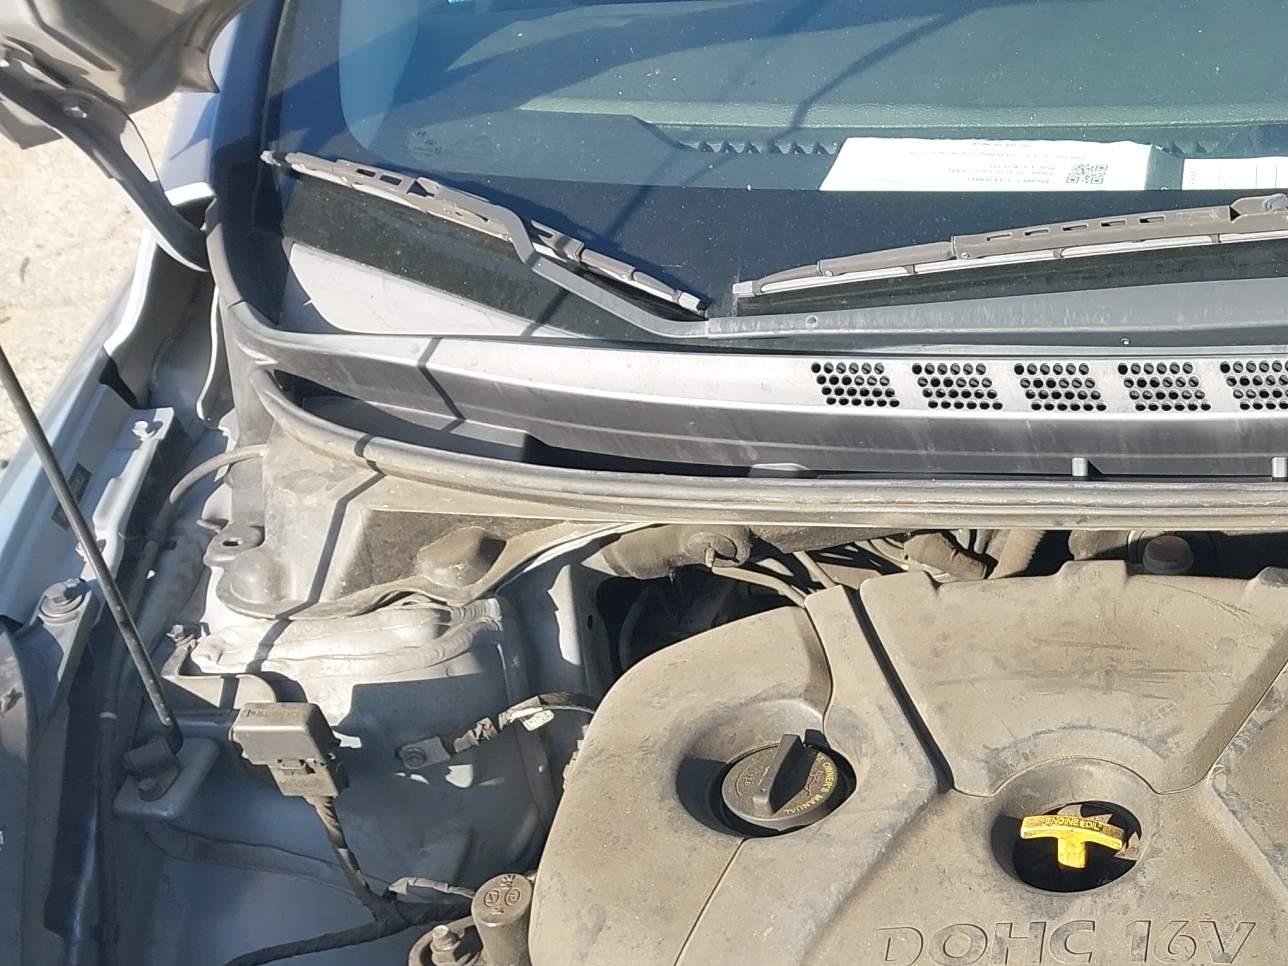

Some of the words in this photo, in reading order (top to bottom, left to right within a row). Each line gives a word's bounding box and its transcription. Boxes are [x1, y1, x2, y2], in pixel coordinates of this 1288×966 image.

[782, 793, 824, 816] MANUAL
[1043, 815, 1078, 826] ENGINE
[1125, 918, 1257, 965] 16V
